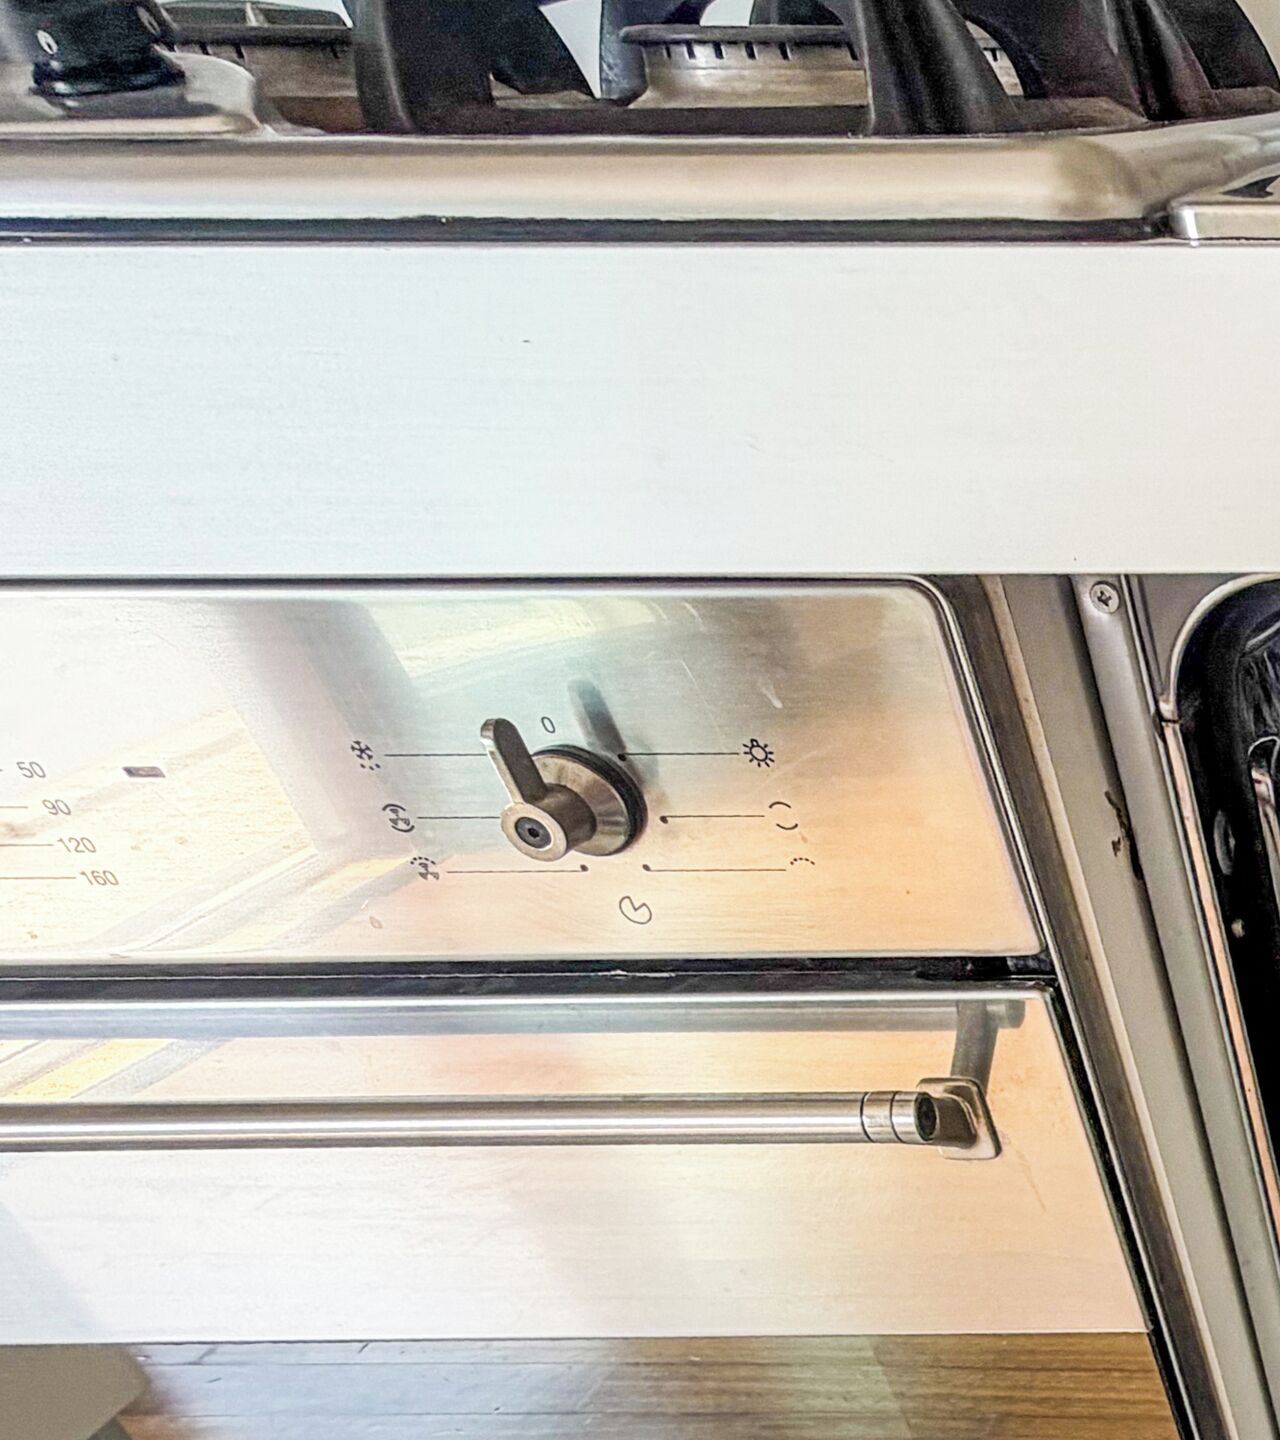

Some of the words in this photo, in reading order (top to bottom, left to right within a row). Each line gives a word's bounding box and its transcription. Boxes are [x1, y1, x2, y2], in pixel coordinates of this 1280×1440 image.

[16, 761, 47, 779] 50
[41, 799, 72, 816] 90
[57, 836, 97, 853] 120
[79, 870, 119, 886] 160
